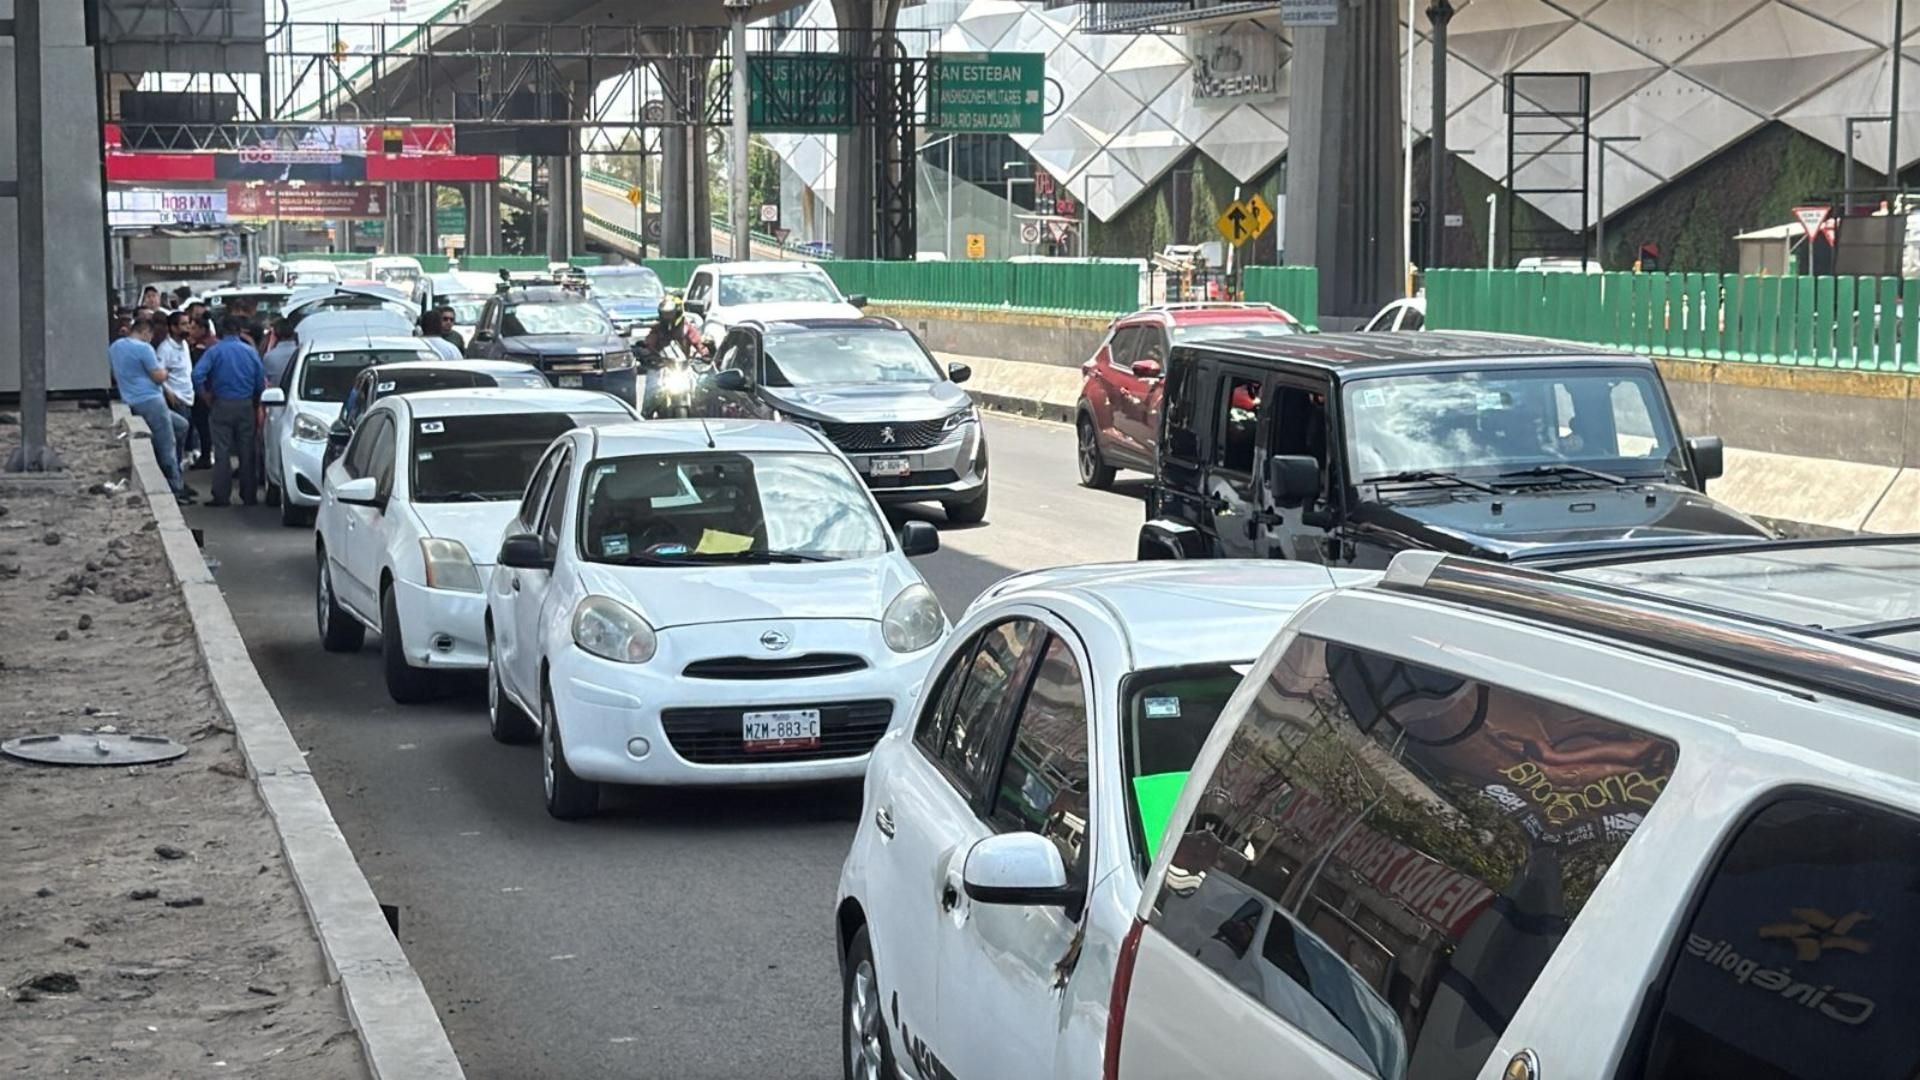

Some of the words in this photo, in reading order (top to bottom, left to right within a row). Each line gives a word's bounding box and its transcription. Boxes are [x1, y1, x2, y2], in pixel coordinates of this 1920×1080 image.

[933, 65, 960, 81] SAN
[963, 65, 1021, 81] ESTEBAN
[973, 113, 987, 128] SAN
[745, 720, 817, 739] MZM-883-C
